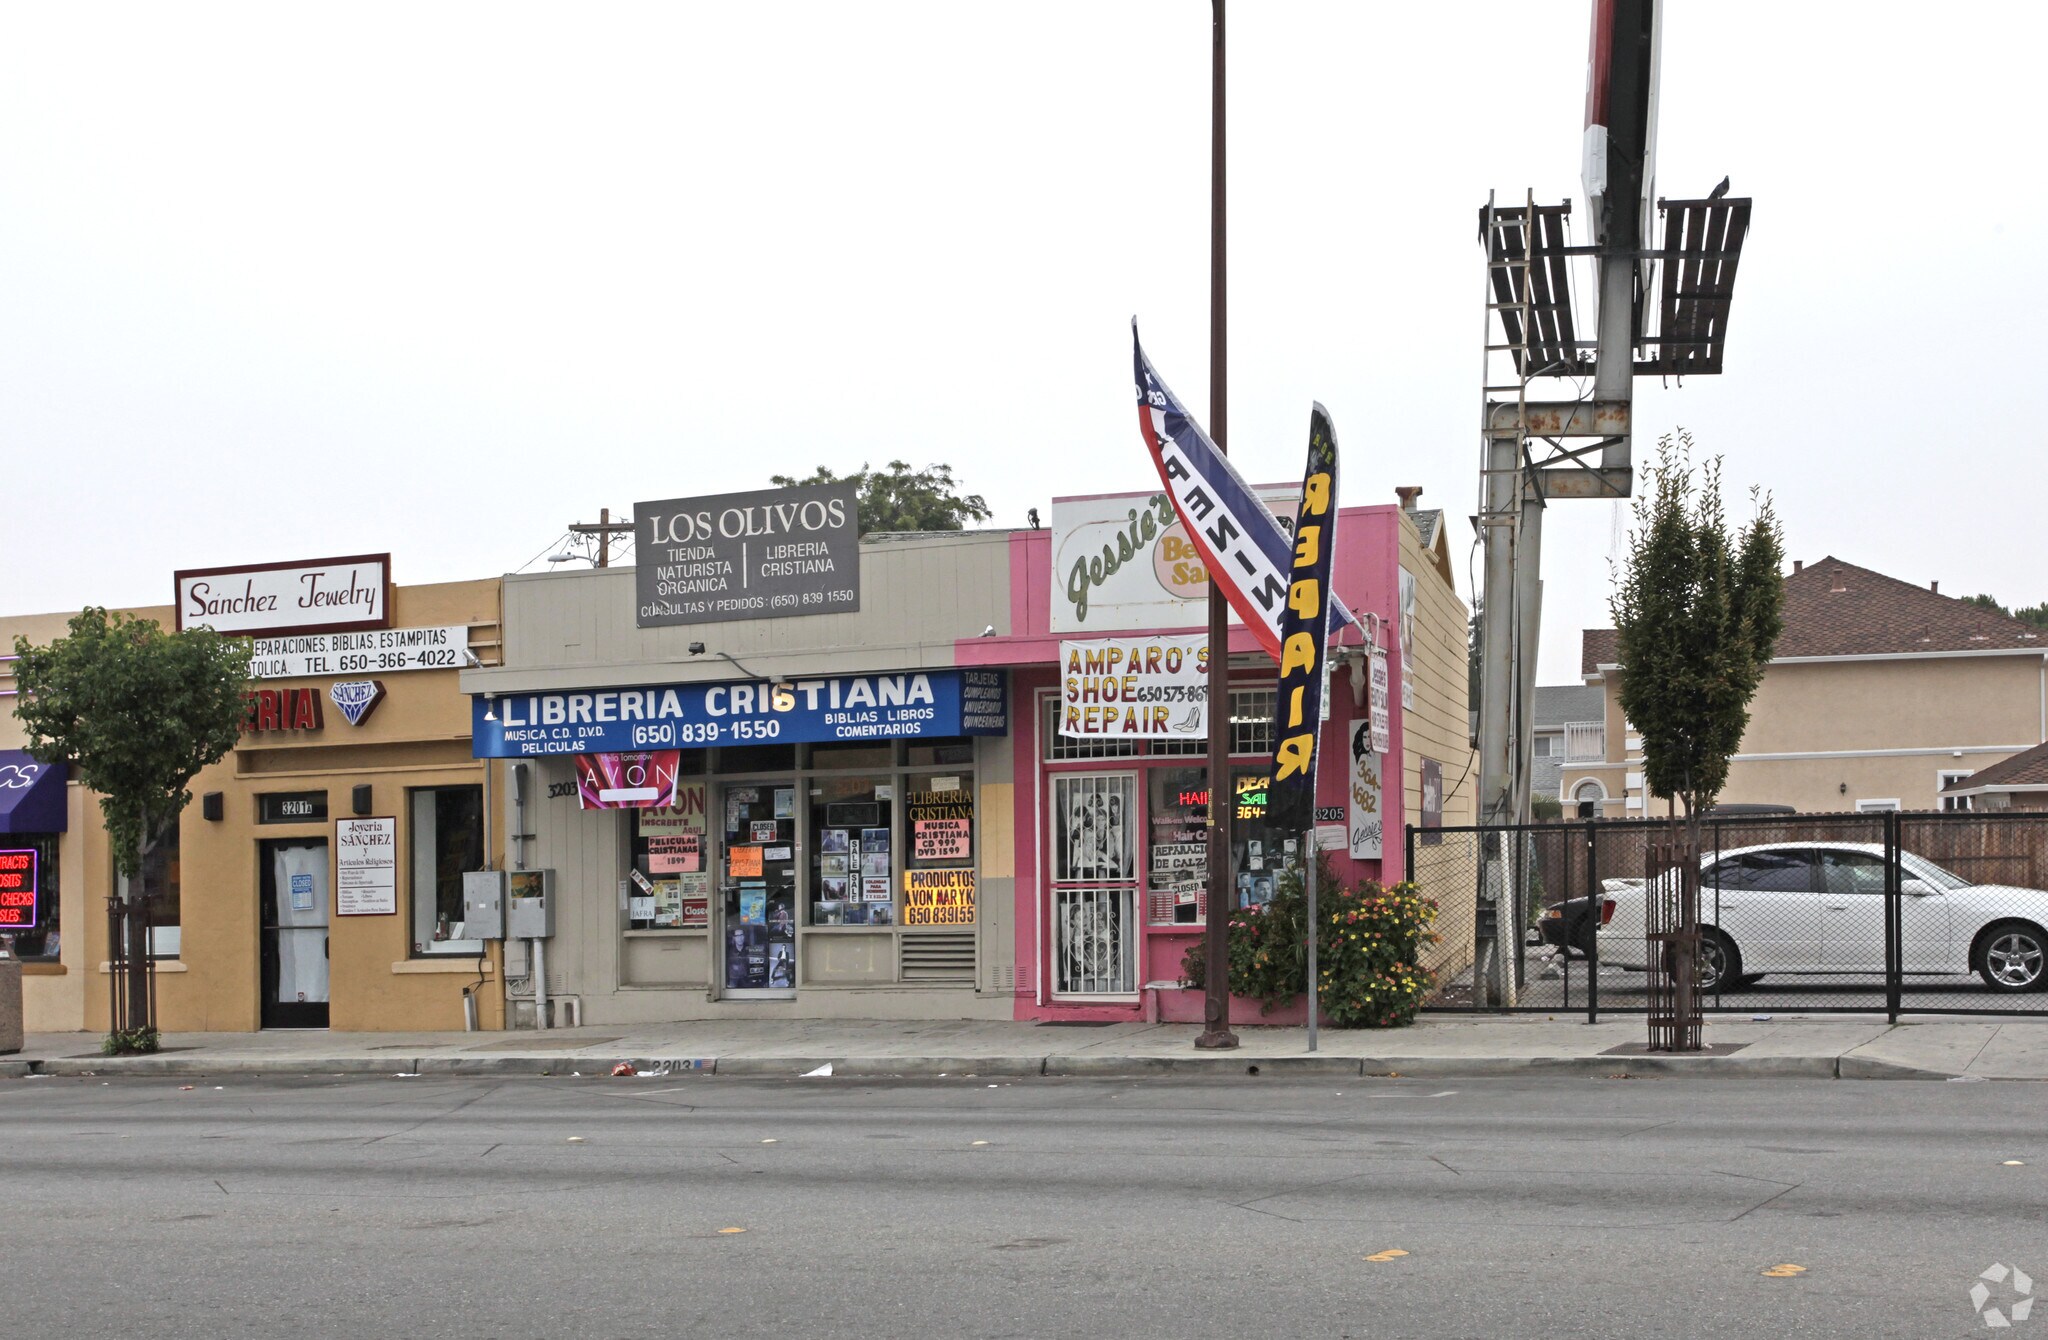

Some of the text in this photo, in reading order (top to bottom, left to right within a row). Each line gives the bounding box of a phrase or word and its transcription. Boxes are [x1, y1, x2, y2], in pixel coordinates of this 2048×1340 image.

[650, 499, 845, 544] LOS OLIVOS
[667, 547, 715, 562] TIENDA
[766, 542, 828, 559] LIBRERIA
[1068, 494, 1177, 622] Jessie's
[657, 562, 732, 580] NATURISTA
[761, 559, 835, 577] CRISTIANA
[298, 570, 376, 615] Jewelry
[659, 578, 728, 595] ORGANICA
[641, 602, 705, 617] CONSULTAS
[707, 601, 714, 611] Y
[771, 593, 799, 609] (650)
[802, 592, 822, 605] 839
[827, 589, 854, 602] 1550
[380, 629, 447, 648] ESTAMPITAS
[305, 656, 334, 673] TEL.
[340, 649, 456, 671] 650-366-4022
[1068, 646, 1208, 675] AMPARO'S
[964, 672, 998, 686] TARJETAS
[1067, 676, 1137, 703] SHOE
[503, 674, 934, 727] LIBRERIA CRISTIANA
[825, 708, 934, 725] BIBLIAS LIBROS
[1066, 706, 1169, 733] REPAIR
[505, 729, 547, 741] MUSICA
[552, 727, 572, 739] C.D.
[632, 719, 780, 748] (650) 839-1550
[836, 722, 921, 737] COMENTARIOS
[522, 740, 585, 754] PELICULAS
[620, 752, 653, 761] Tomorrow
[585, 764, 674, 788] AVON
[912, 790, 973, 804] LIBRERIA
[909, 806, 974, 821] CRISTIANA
[1316, 808, 1344, 819] 3205
[753, 823, 774, 831] CLOSED
[924, 821, 960, 829] MUSICA
[915, 831, 970, 839] CRISTIANA
[918, 848, 936, 856] DVD
[1156, 859, 1169, 869] DE
[911, 871, 975, 888] PRODUCTOS
[1172, 883, 1199, 894] CLOSED
[1, 892, 34, 906] CHECKS
[905, 890, 933, 906] AVON
[632, 910, 653, 918] JAFRA
[910, 907, 930, 924] 650
